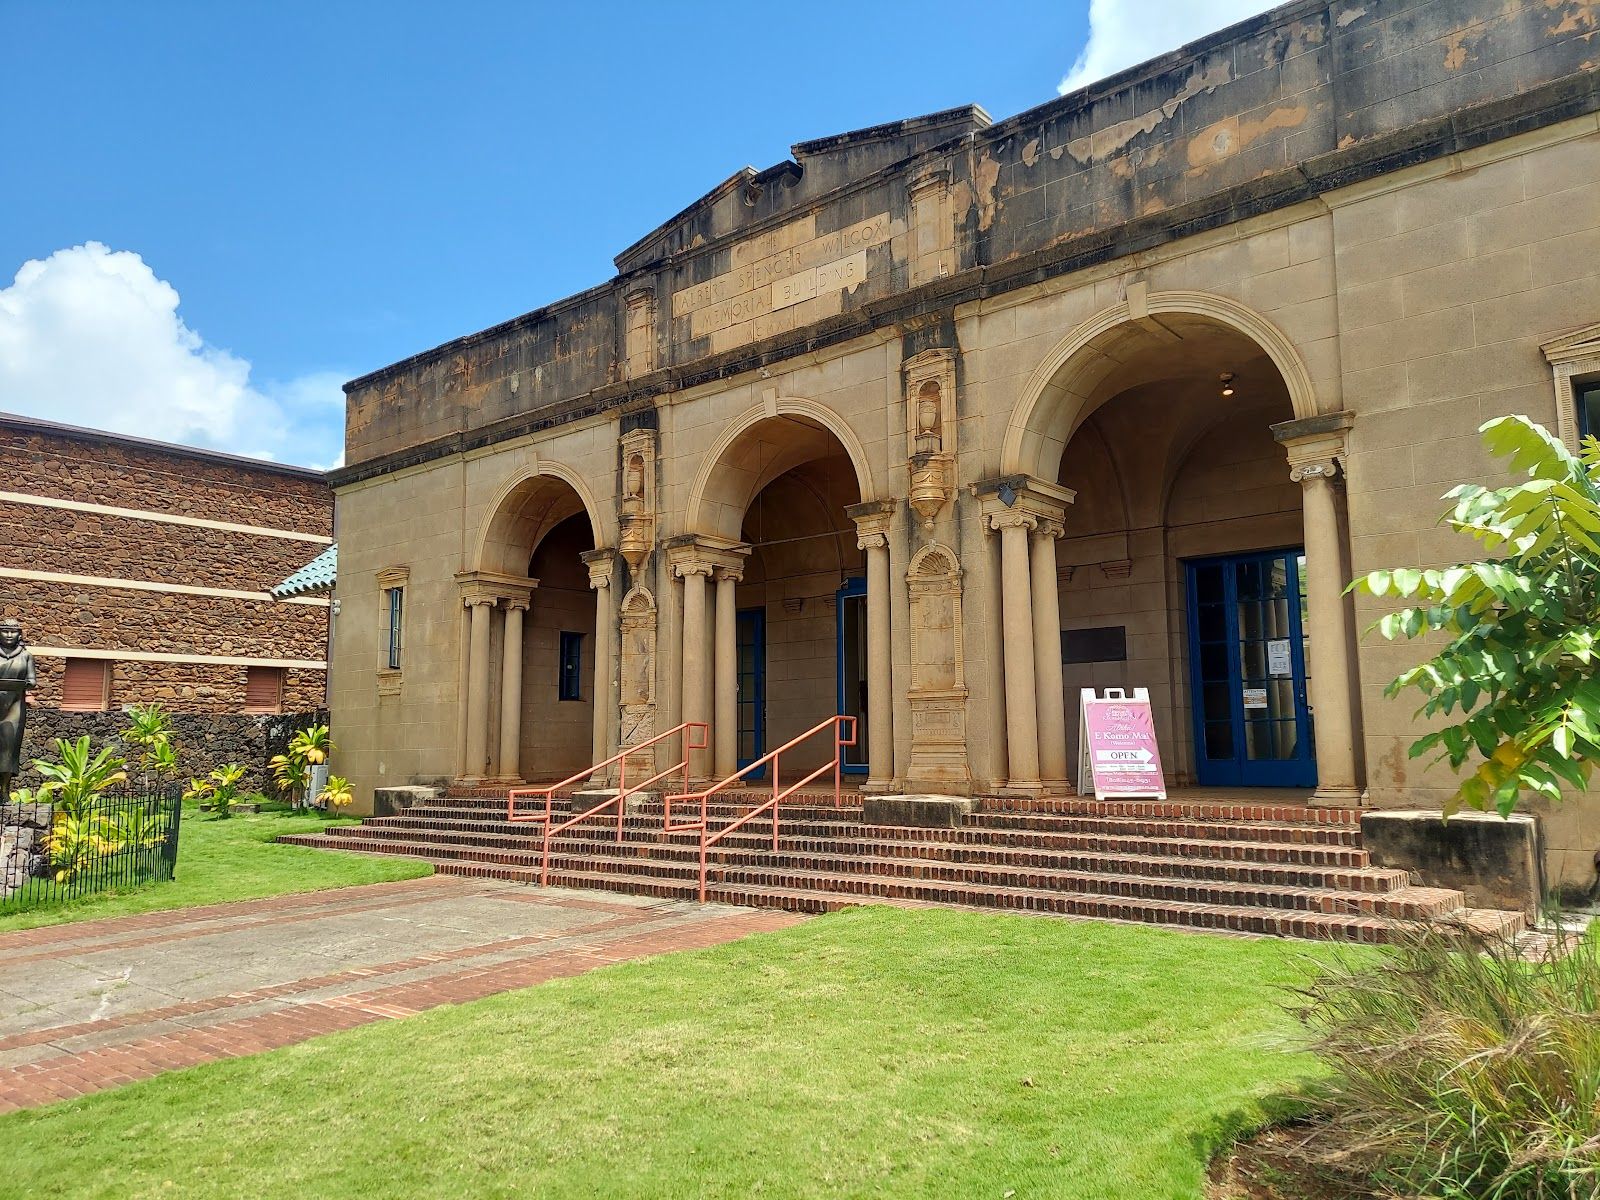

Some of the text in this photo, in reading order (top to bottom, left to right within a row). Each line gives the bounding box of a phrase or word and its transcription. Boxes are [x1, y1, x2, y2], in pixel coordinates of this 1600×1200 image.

[681, 221, 885, 308] ALBERT SPENCER WILCOX
[703, 262, 854, 327] MEMORIAL BUILDING
[1095, 732, 1102, 740] E
[1104, 732, 1130, 740] Komo
[1110, 752, 1138, 760] OPEN
